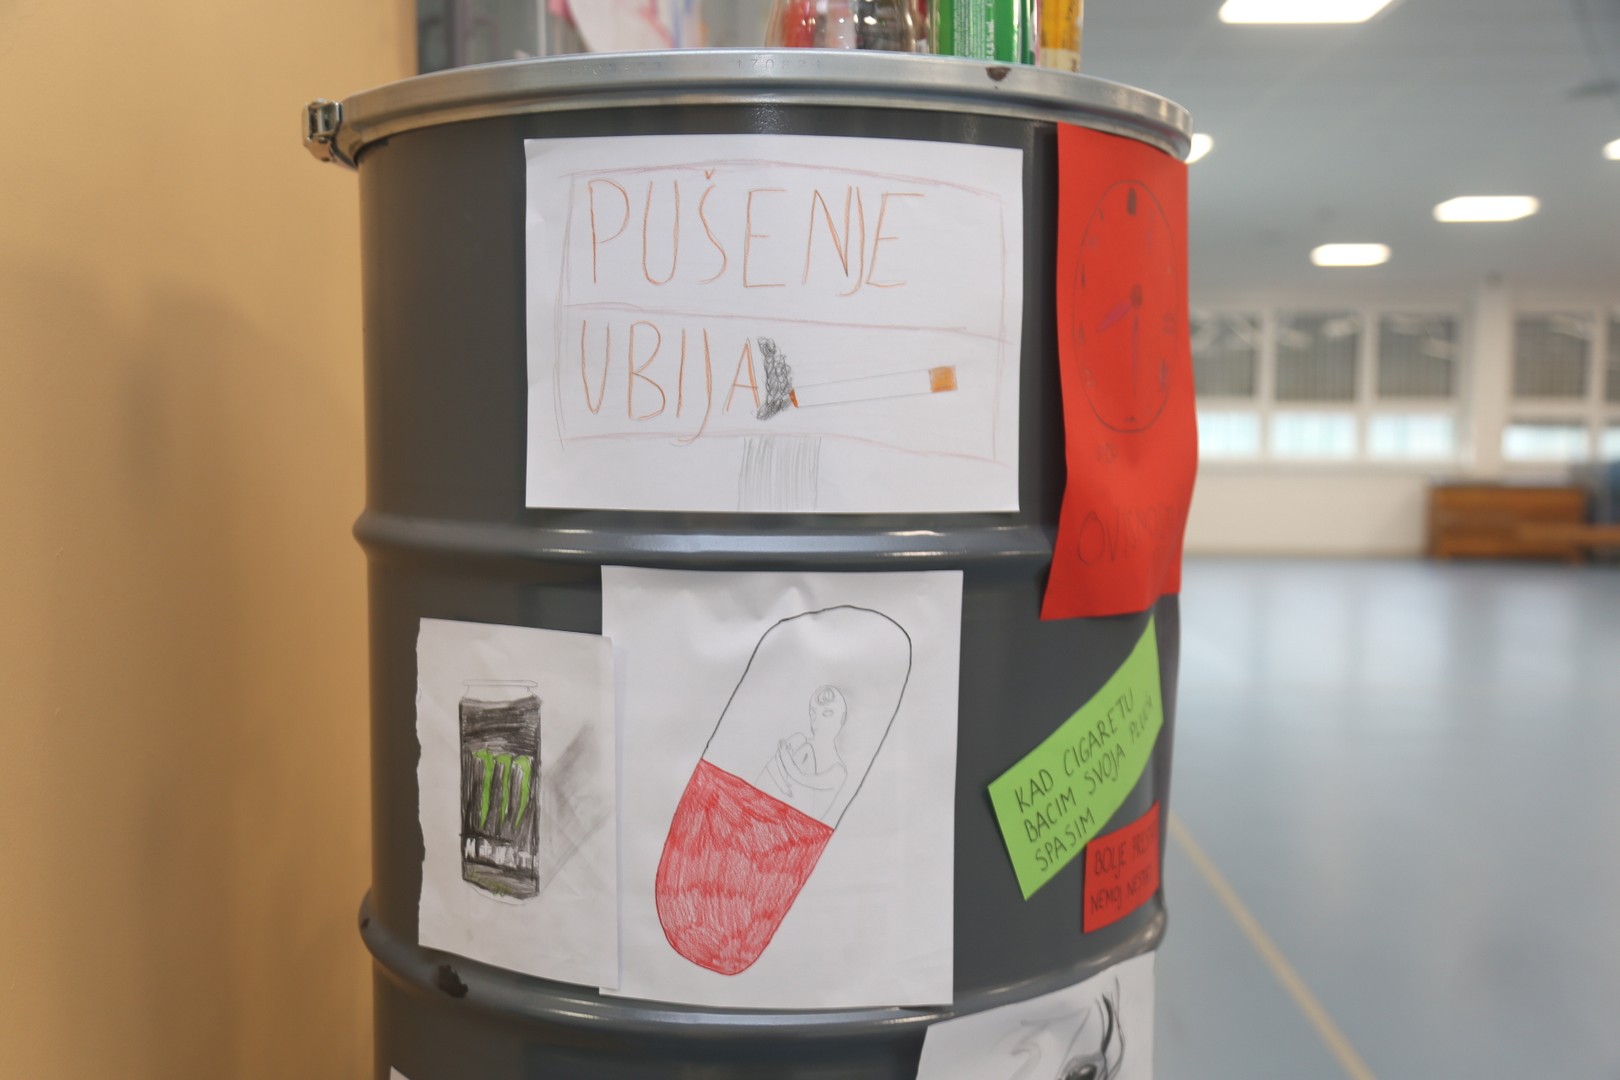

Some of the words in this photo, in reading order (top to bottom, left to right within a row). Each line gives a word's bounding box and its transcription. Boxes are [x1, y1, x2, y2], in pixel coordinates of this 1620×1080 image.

[587, 169, 925, 297] PUŠENJE
[581, 320, 761, 446] UBIJA
[1014, 768, 1054, 813] KAD
[1063, 688, 1134, 777] CIGARETU
[1024, 787, 1076, 843] BACIM
[1084, 743, 1125, 796] SVOJA
[1034, 807, 1096, 872] SPASIM
[1094, 840, 1126, 879] BOLJE
[1090, 885, 1122, 916] NEMOJ
